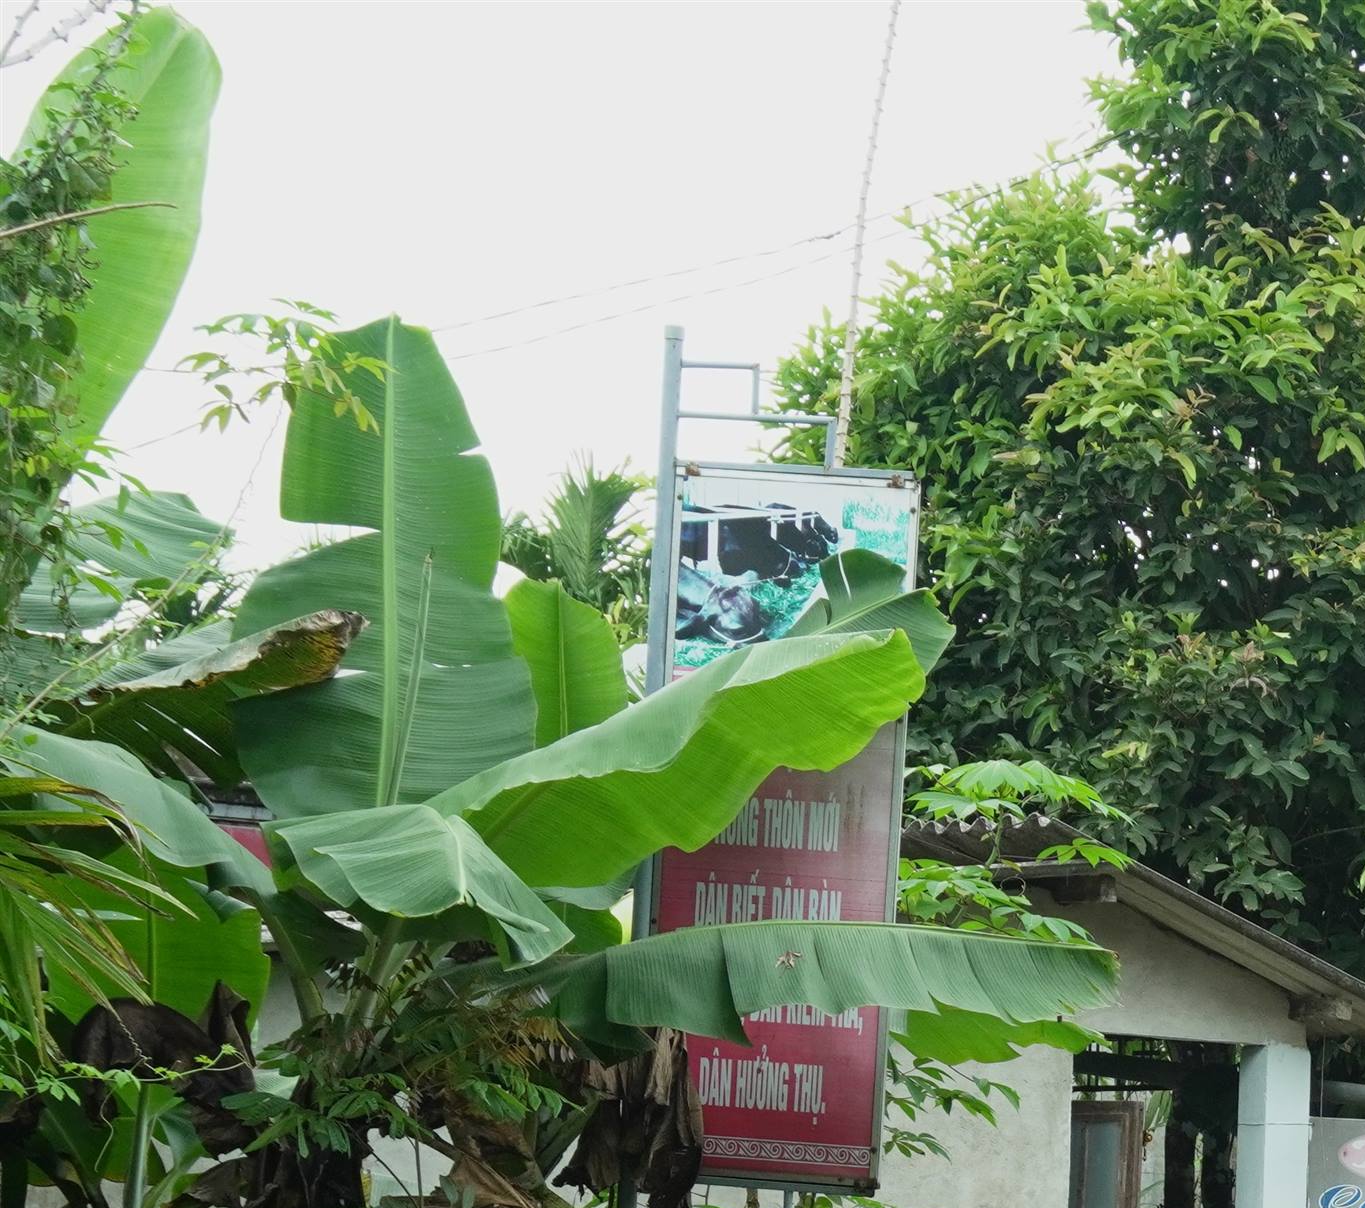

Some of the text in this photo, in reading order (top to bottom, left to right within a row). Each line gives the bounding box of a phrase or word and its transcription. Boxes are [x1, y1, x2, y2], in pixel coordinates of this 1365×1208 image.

[764, 789, 805, 850] THÔN
[808, 792, 841, 852] MỚI
[694, 869, 842, 927] DÂN BIẾT DÂN BÀN
[699, 1045, 826, 1125] DÂN HƯỞNG THỤ.
